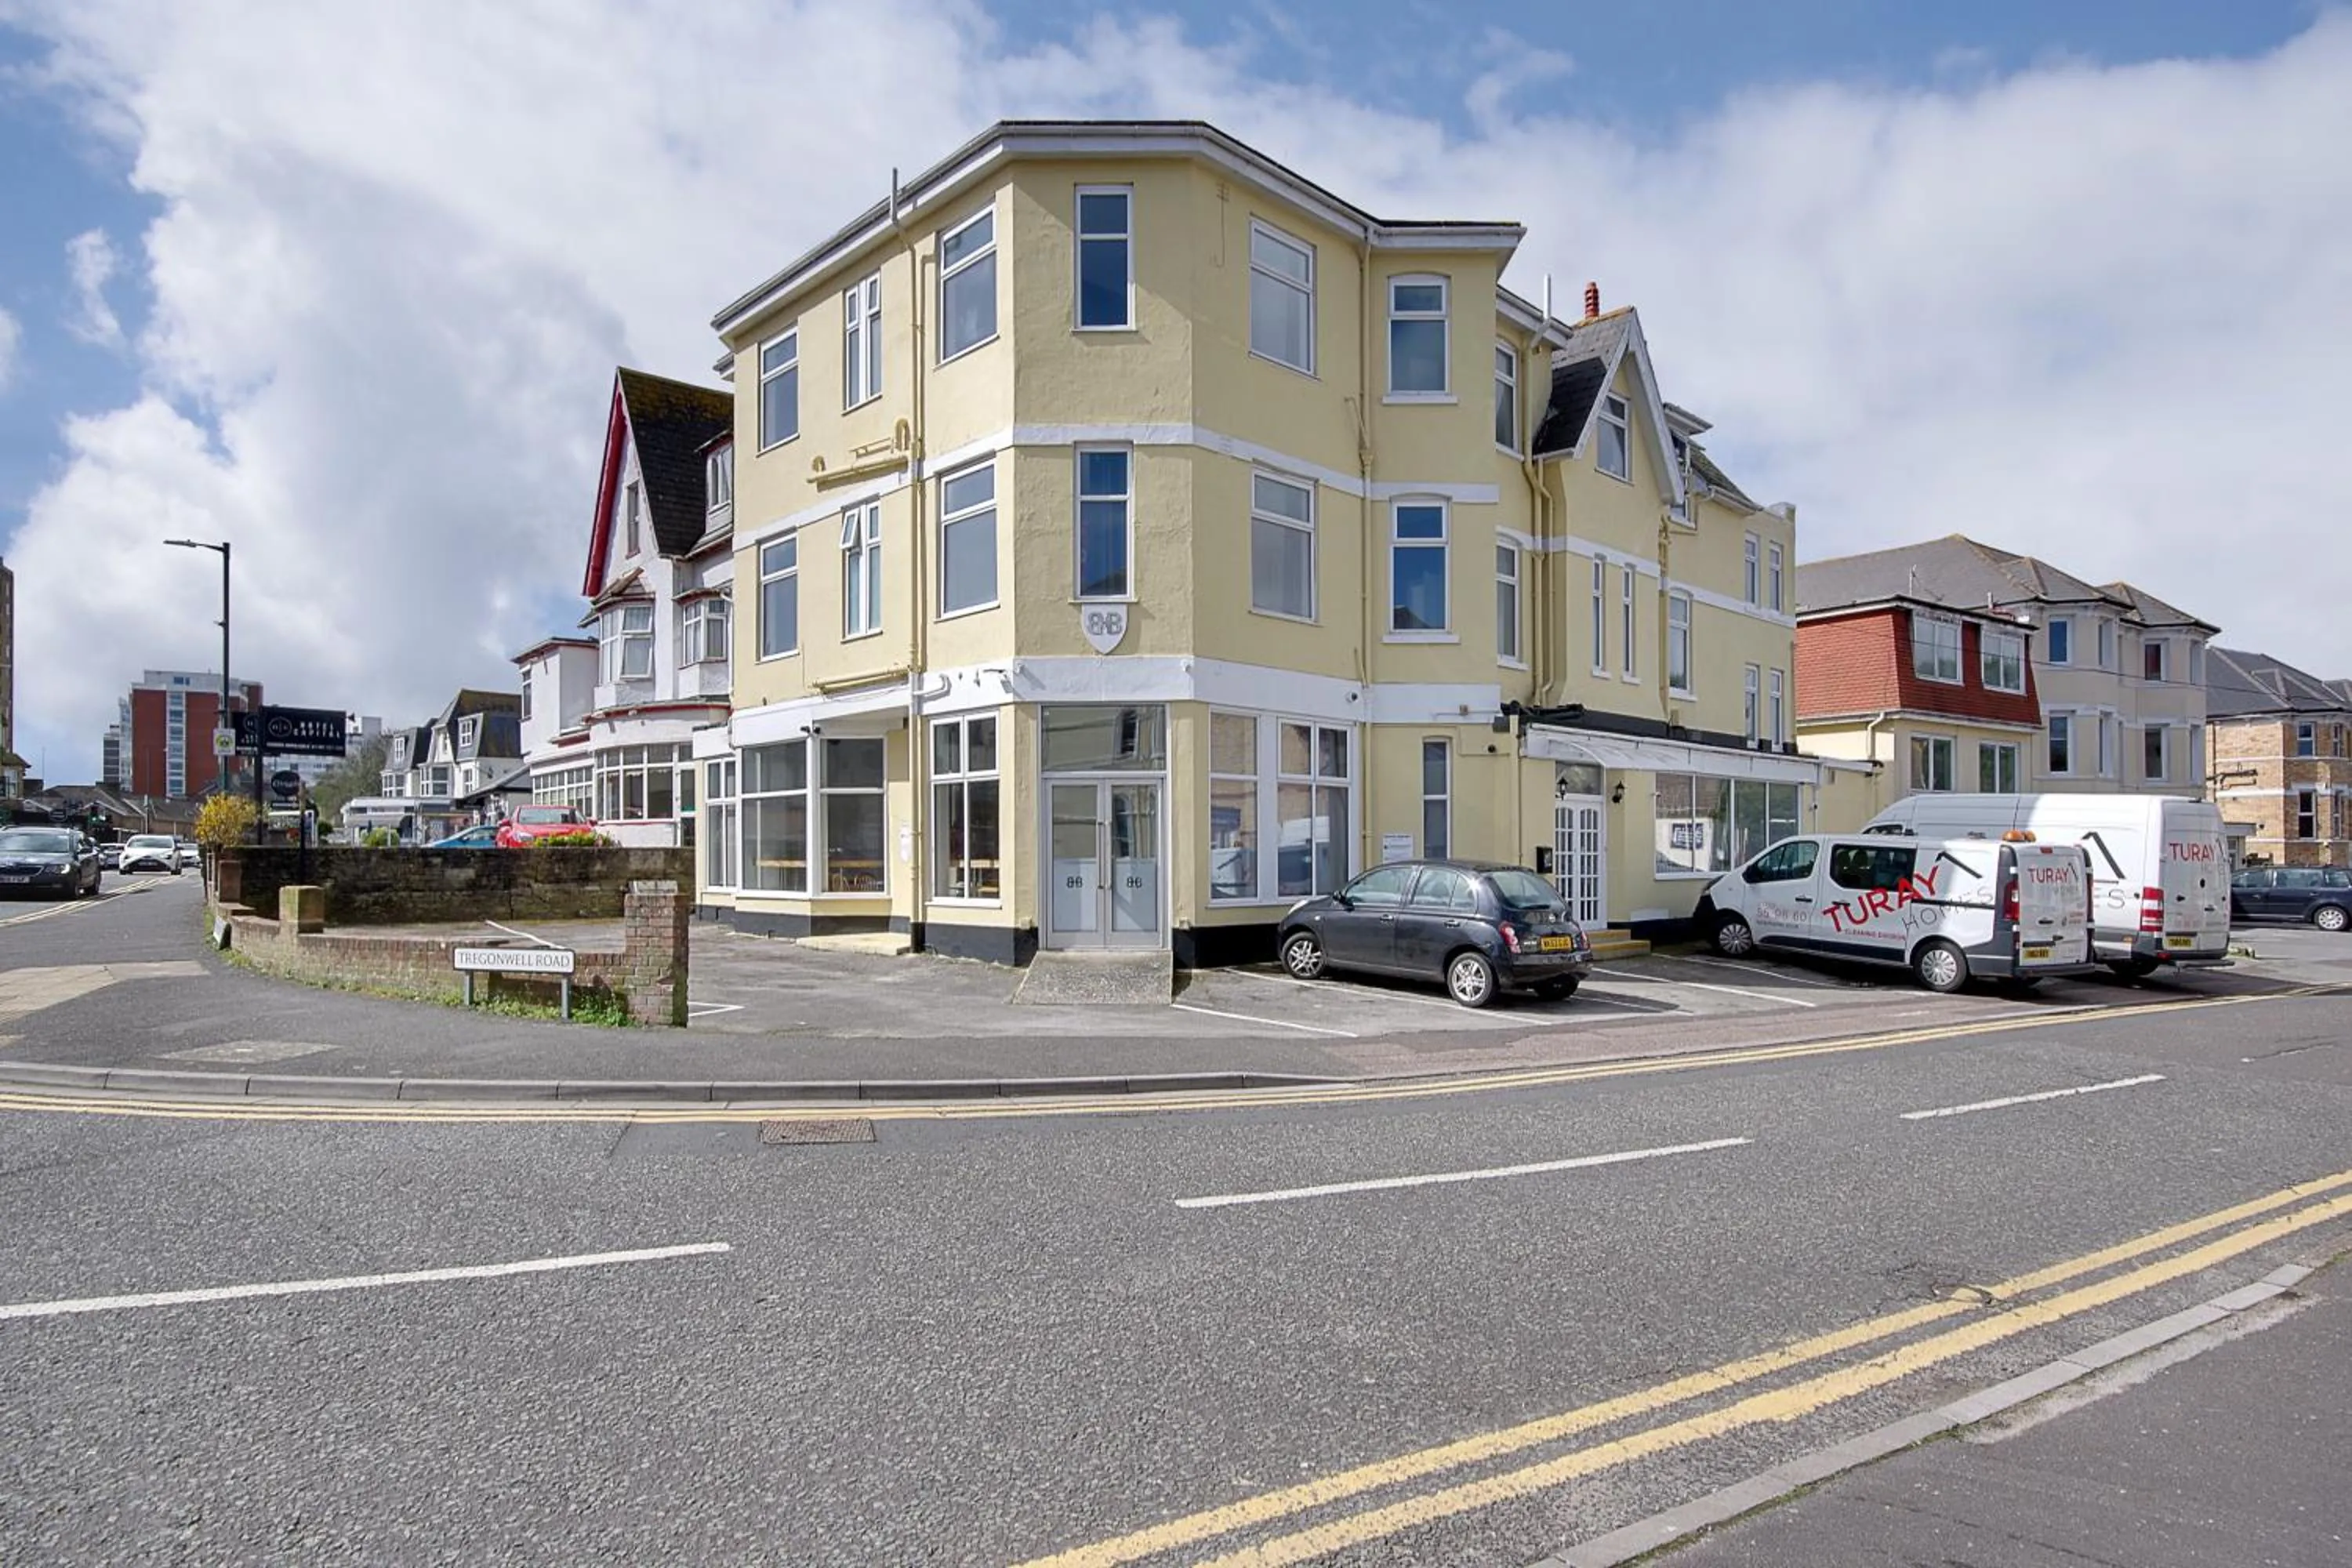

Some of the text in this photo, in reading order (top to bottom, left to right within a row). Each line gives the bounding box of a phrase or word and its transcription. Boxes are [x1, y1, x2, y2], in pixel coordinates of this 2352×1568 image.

[2169, 842, 2217, 862] TURAY
[2027, 867, 2069, 884] TURAY
[1823, 865, 1939, 932] TURAY
[1901, 885, 1994, 930] HOMES
[459, 952, 570, 967] TREGONWELL ROAD
